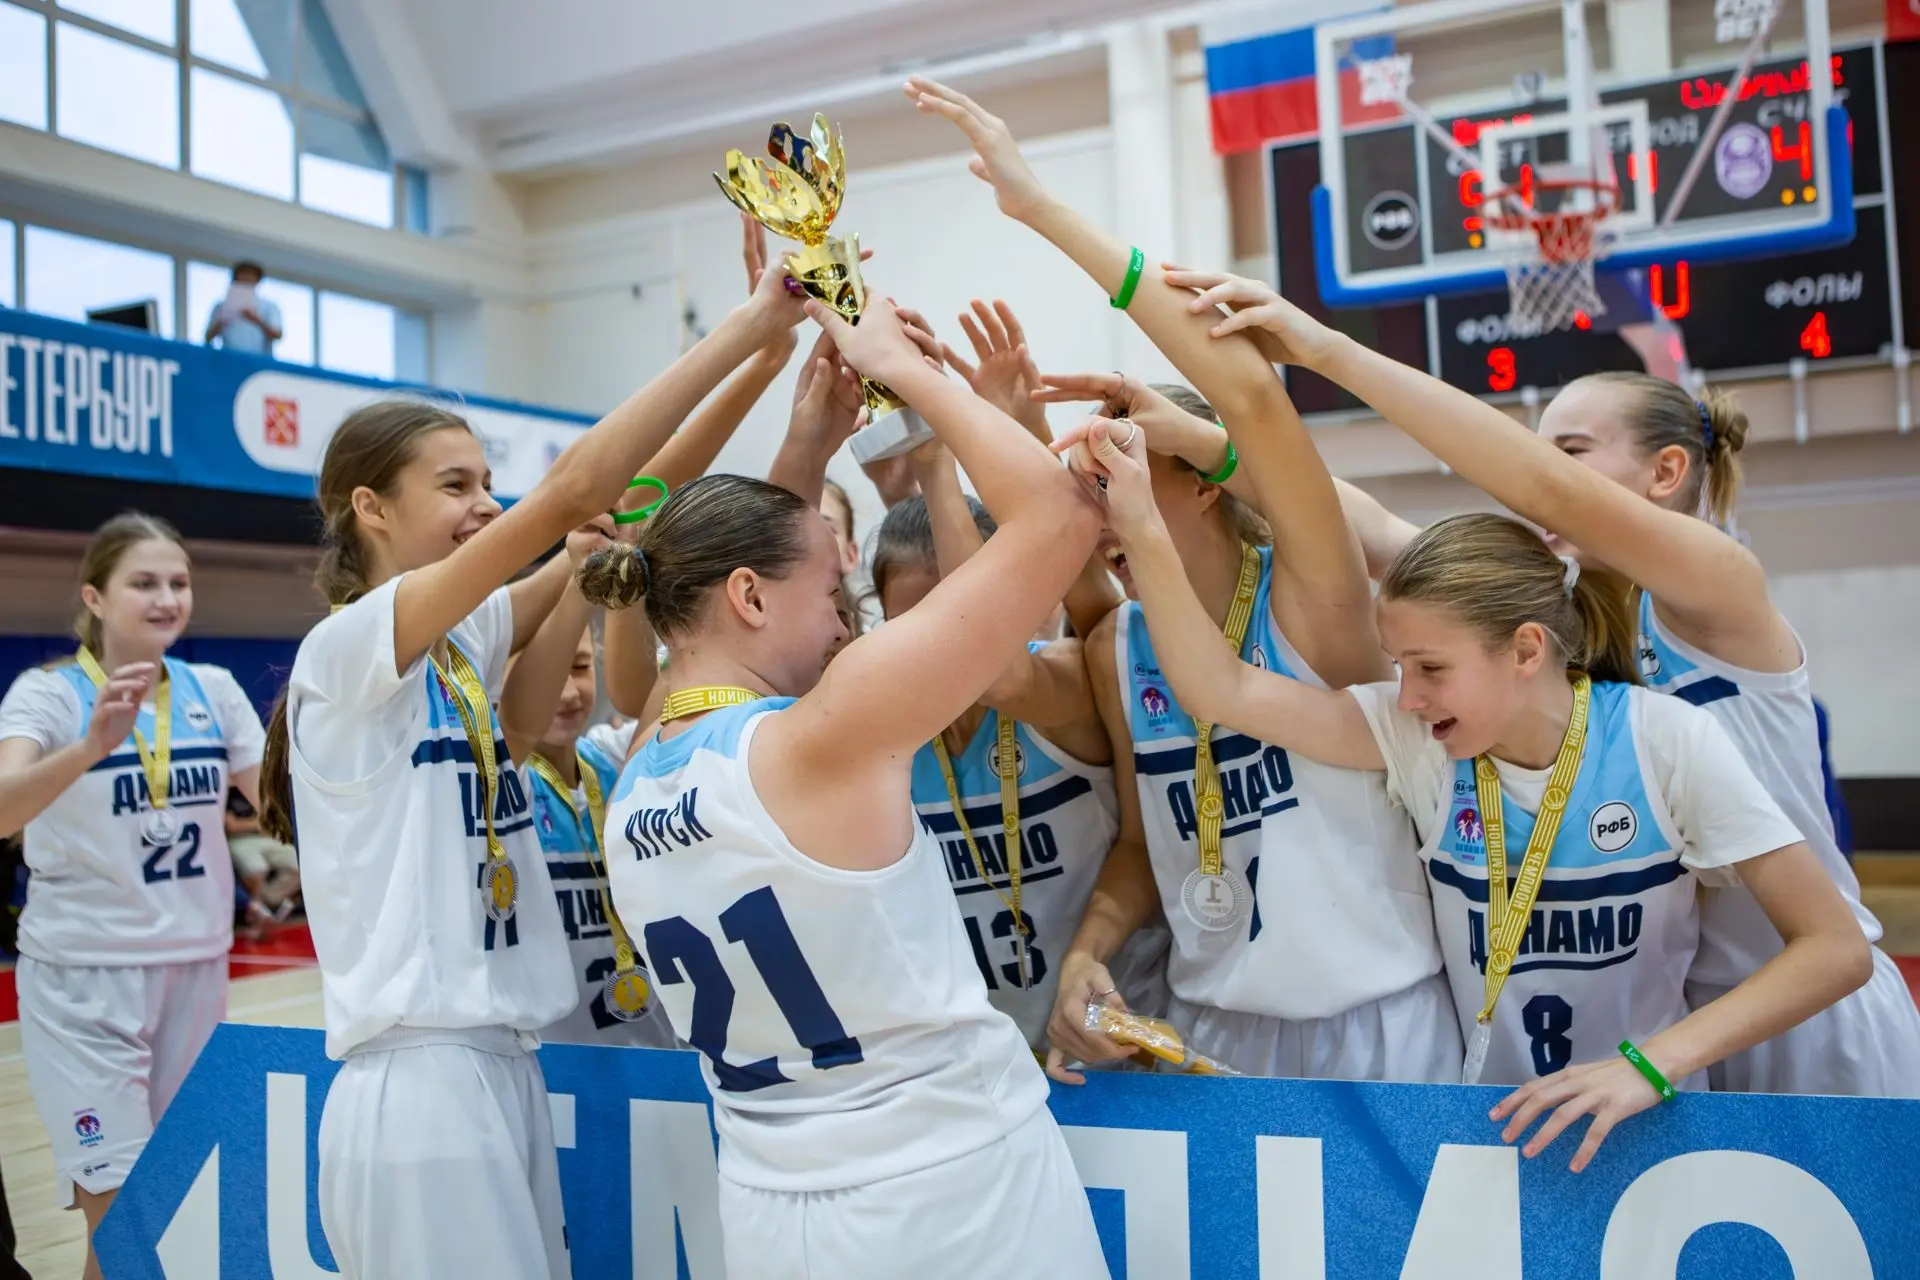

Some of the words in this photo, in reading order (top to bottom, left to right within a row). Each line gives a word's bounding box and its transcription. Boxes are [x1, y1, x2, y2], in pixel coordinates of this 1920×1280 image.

[1765, 271, 1863, 308] ФОЛЫ
[1801, 312, 1831, 358] 4
[1488, 348, 1516, 391] 3
[142, 822, 206, 884] 22
[625, 787, 713, 861] КУРСК
[1486, 823, 1504, 885] ЧЕМПИОН
[1597, 816, 1630, 837] РФБ
[1513, 851, 1543, 910] ЧЕМПИОН
[963, 909, 1048, 989] 13
[1468, 902, 1643, 975] ДНАМО
[644, 885, 864, 1092] 21
[1522, 995, 1573, 1077] 8
